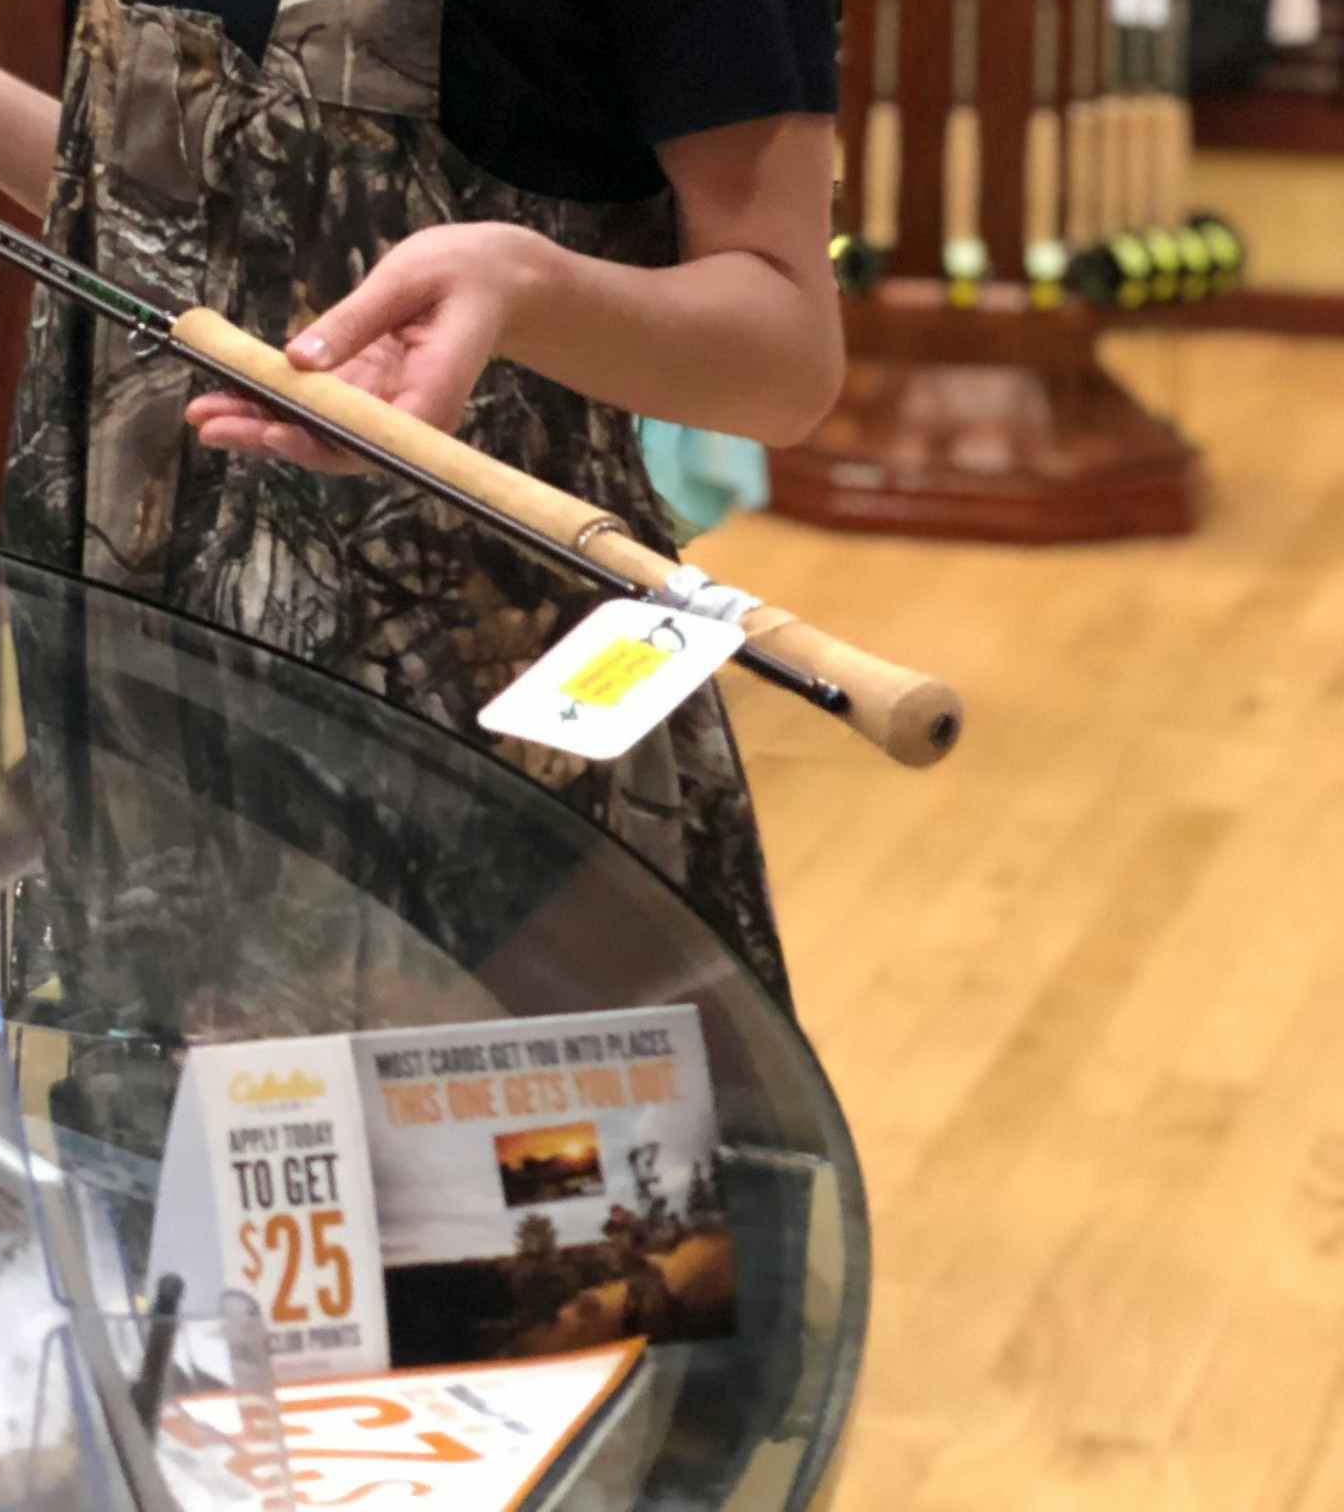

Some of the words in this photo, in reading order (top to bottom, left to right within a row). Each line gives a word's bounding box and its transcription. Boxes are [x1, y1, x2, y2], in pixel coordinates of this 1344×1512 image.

[489, 1040, 521, 1071] GET
[383, 1083, 444, 1128] THIS
[445, 1078, 497, 1121] ONE
[503, 1072, 569, 1116] GETS
[232, 1159, 274, 1211] TO
[282, 1153, 340, 1207] GET
[238, 1209, 354, 1324] $25
